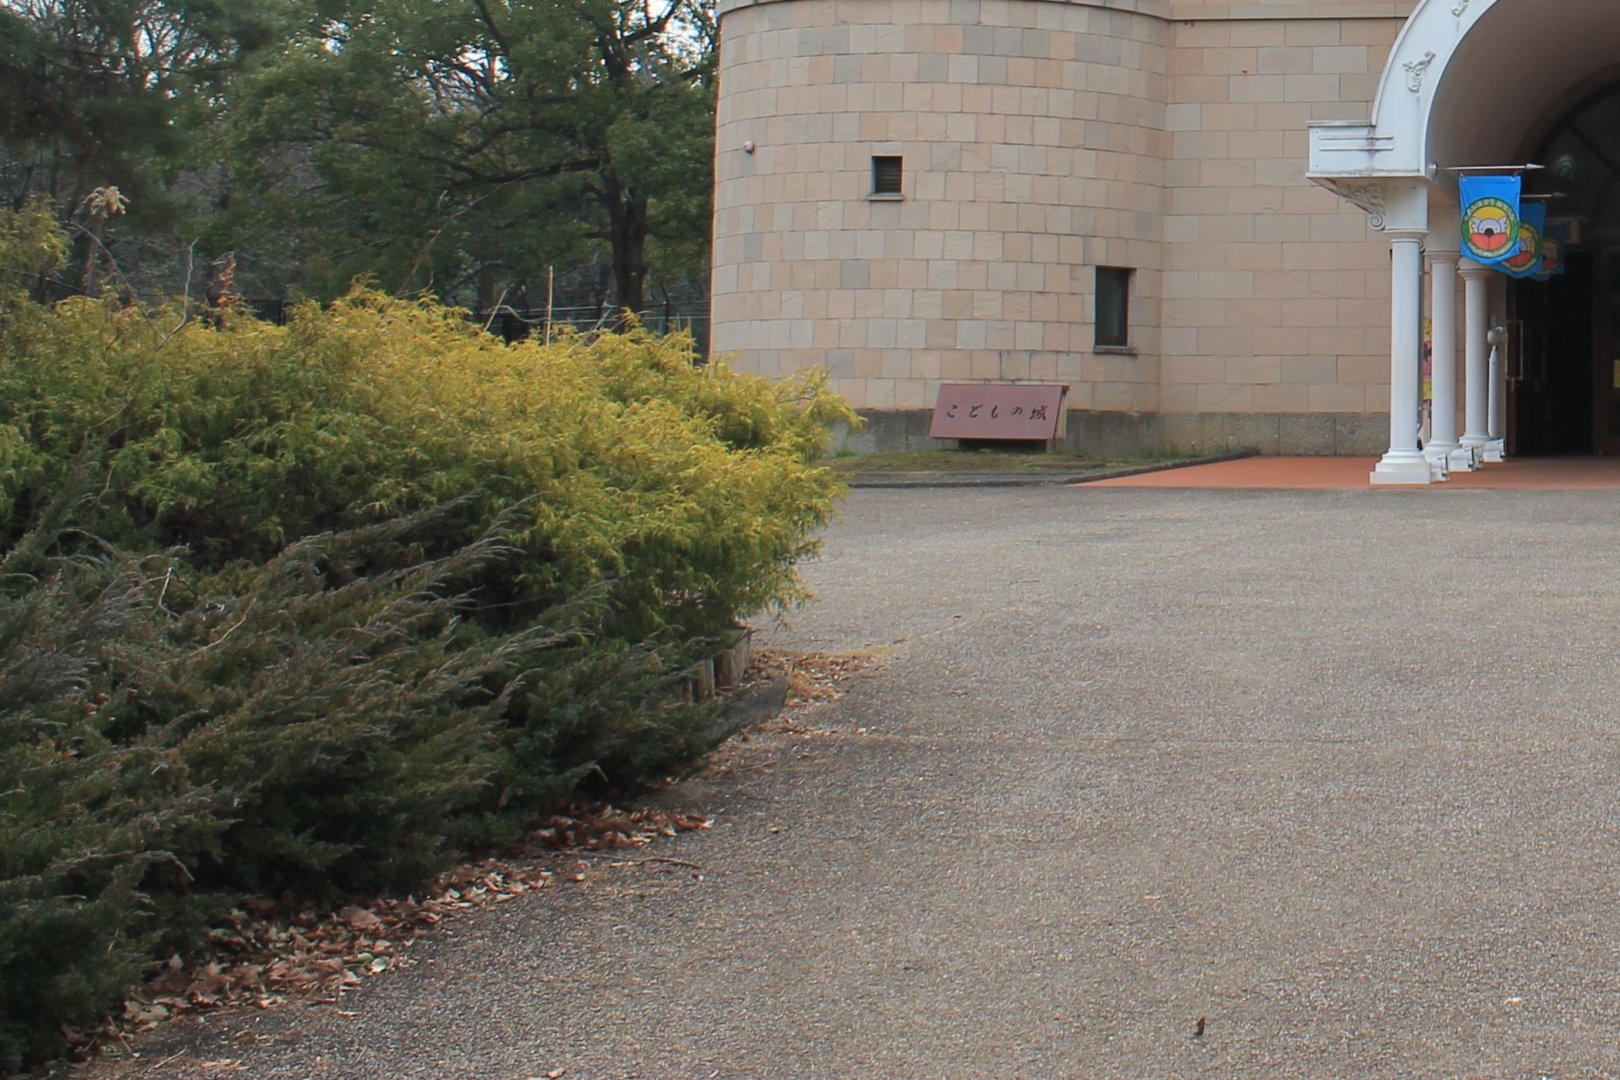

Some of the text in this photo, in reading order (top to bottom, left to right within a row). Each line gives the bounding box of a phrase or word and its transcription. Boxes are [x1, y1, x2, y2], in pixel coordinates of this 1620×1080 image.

[946, 404, 1048, 421] こどもの城
